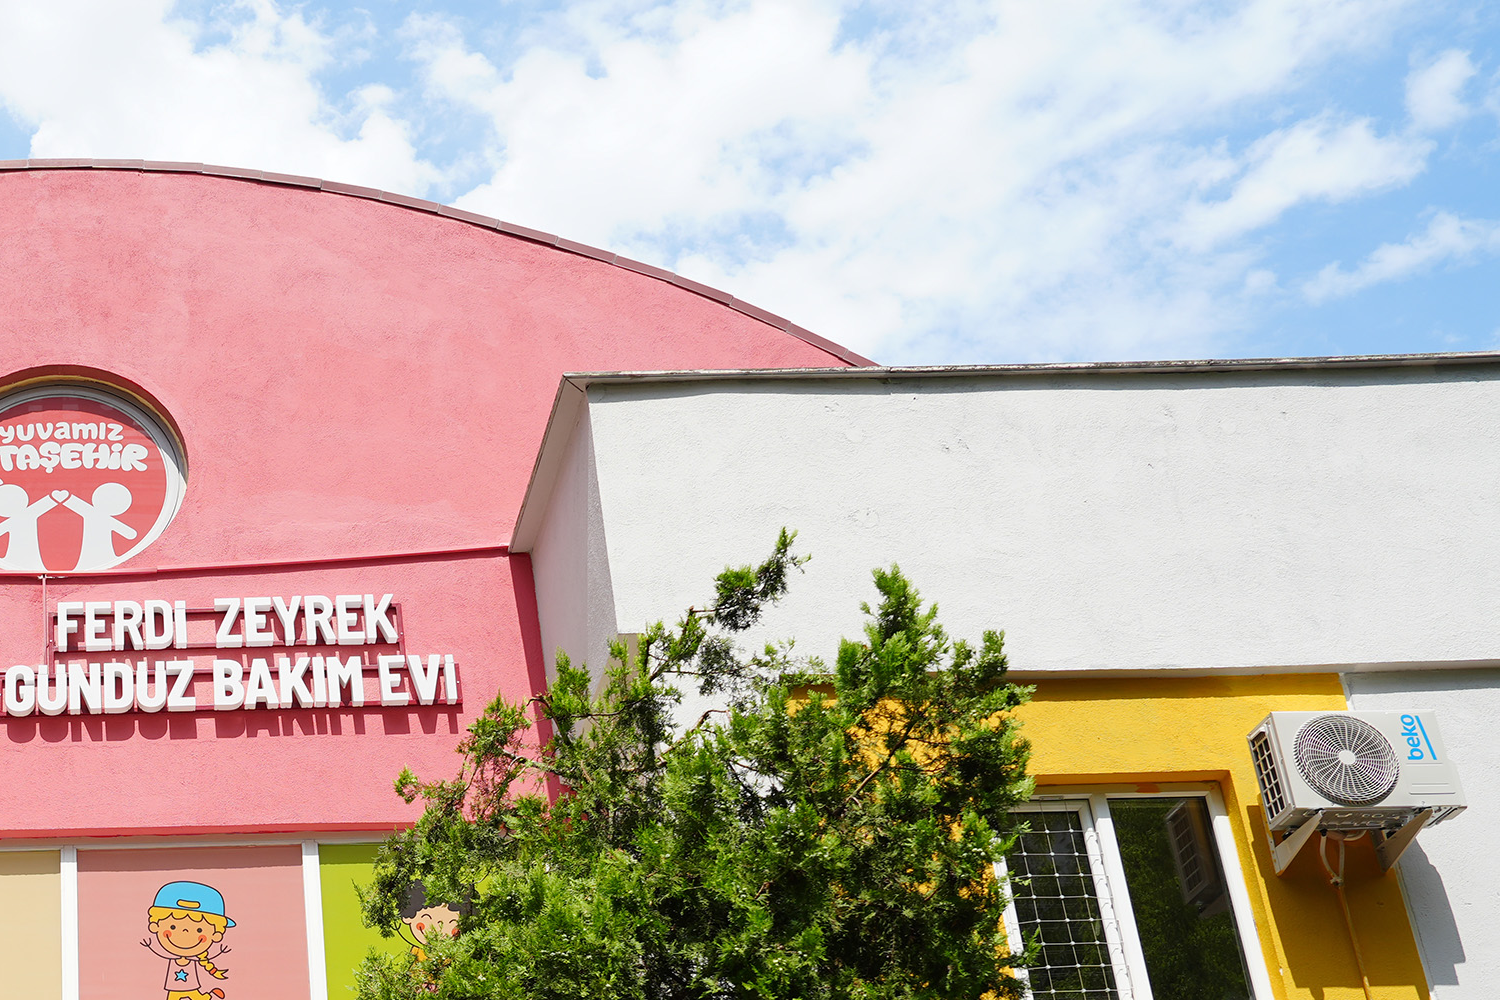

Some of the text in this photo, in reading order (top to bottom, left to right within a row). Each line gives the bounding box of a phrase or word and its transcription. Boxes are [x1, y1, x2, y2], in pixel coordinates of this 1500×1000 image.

[57, 593, 398, 652] FERDİ ZEYREK
[213, 655, 364, 710] BAKIM
[378, 654, 459, 706] EVİ
[1400, 714, 1424, 761] beko
